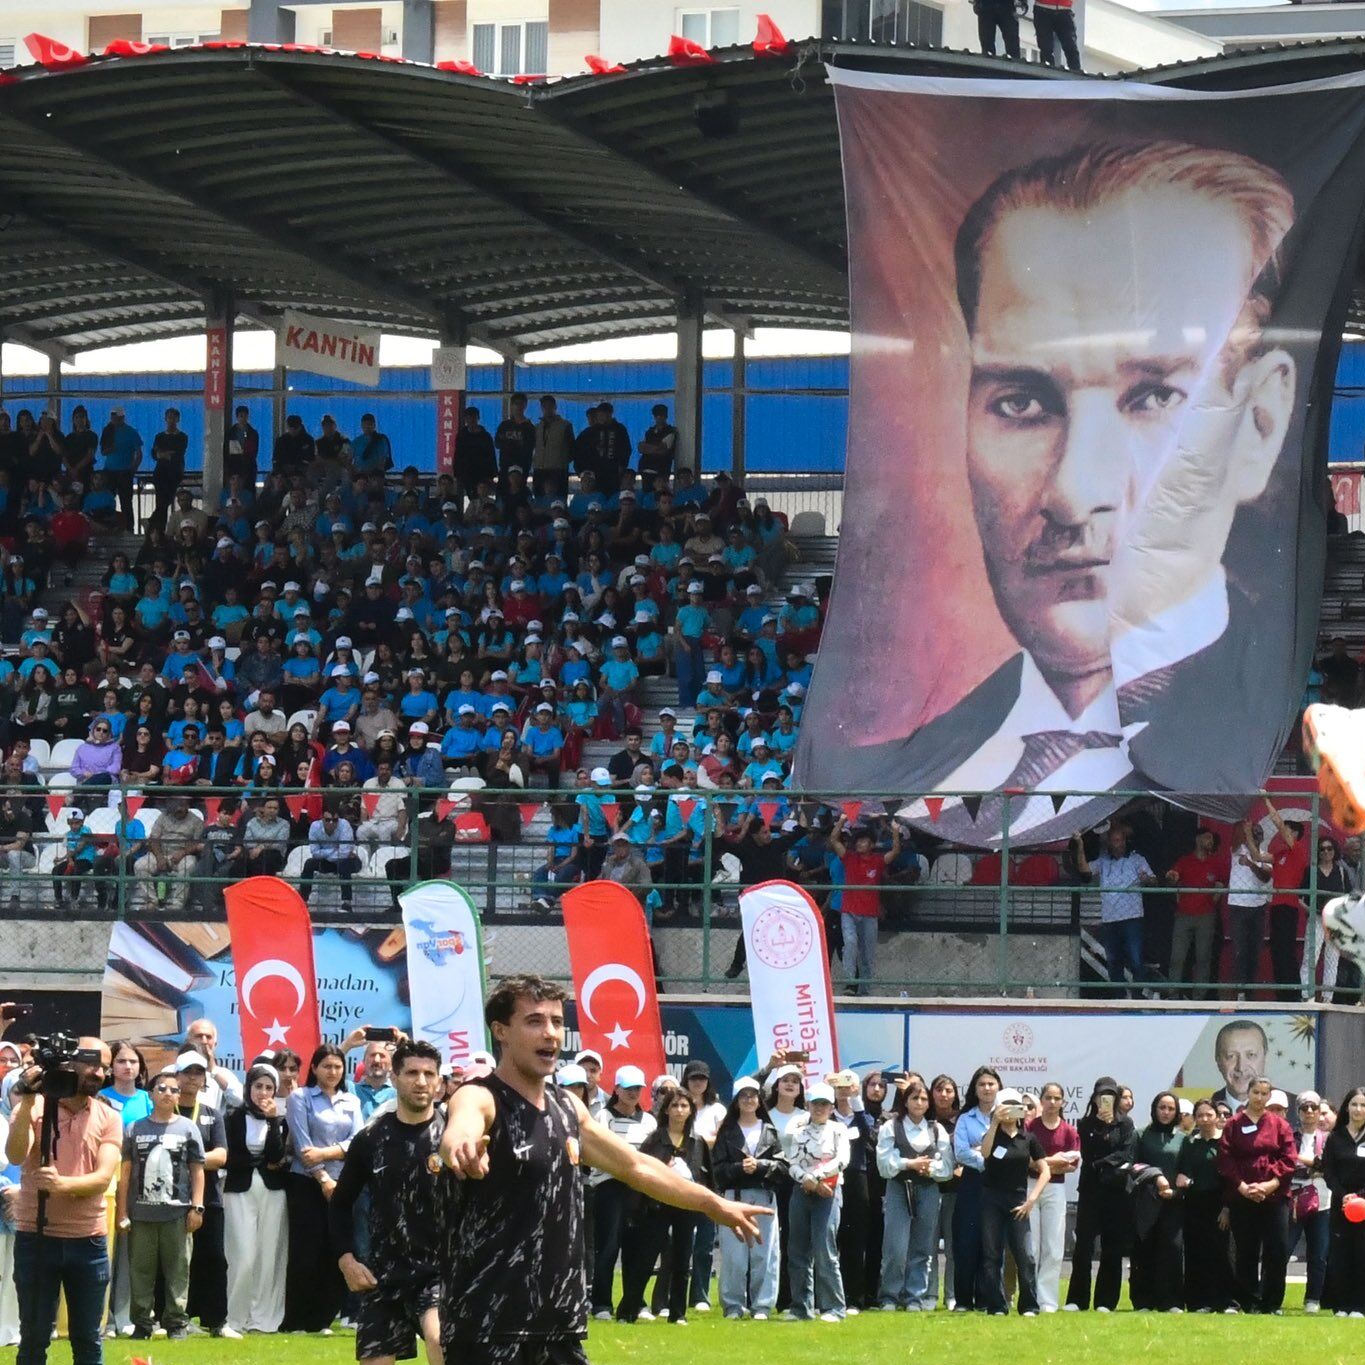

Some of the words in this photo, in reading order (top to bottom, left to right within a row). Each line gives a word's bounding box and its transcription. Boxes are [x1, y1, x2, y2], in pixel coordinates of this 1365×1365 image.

[210, 334, 220, 404] KANTİN
[286, 325, 374, 367] KANTİN
[443, 395, 453, 466] KANTİN
[1066, 1086, 1083, 1099] VE
